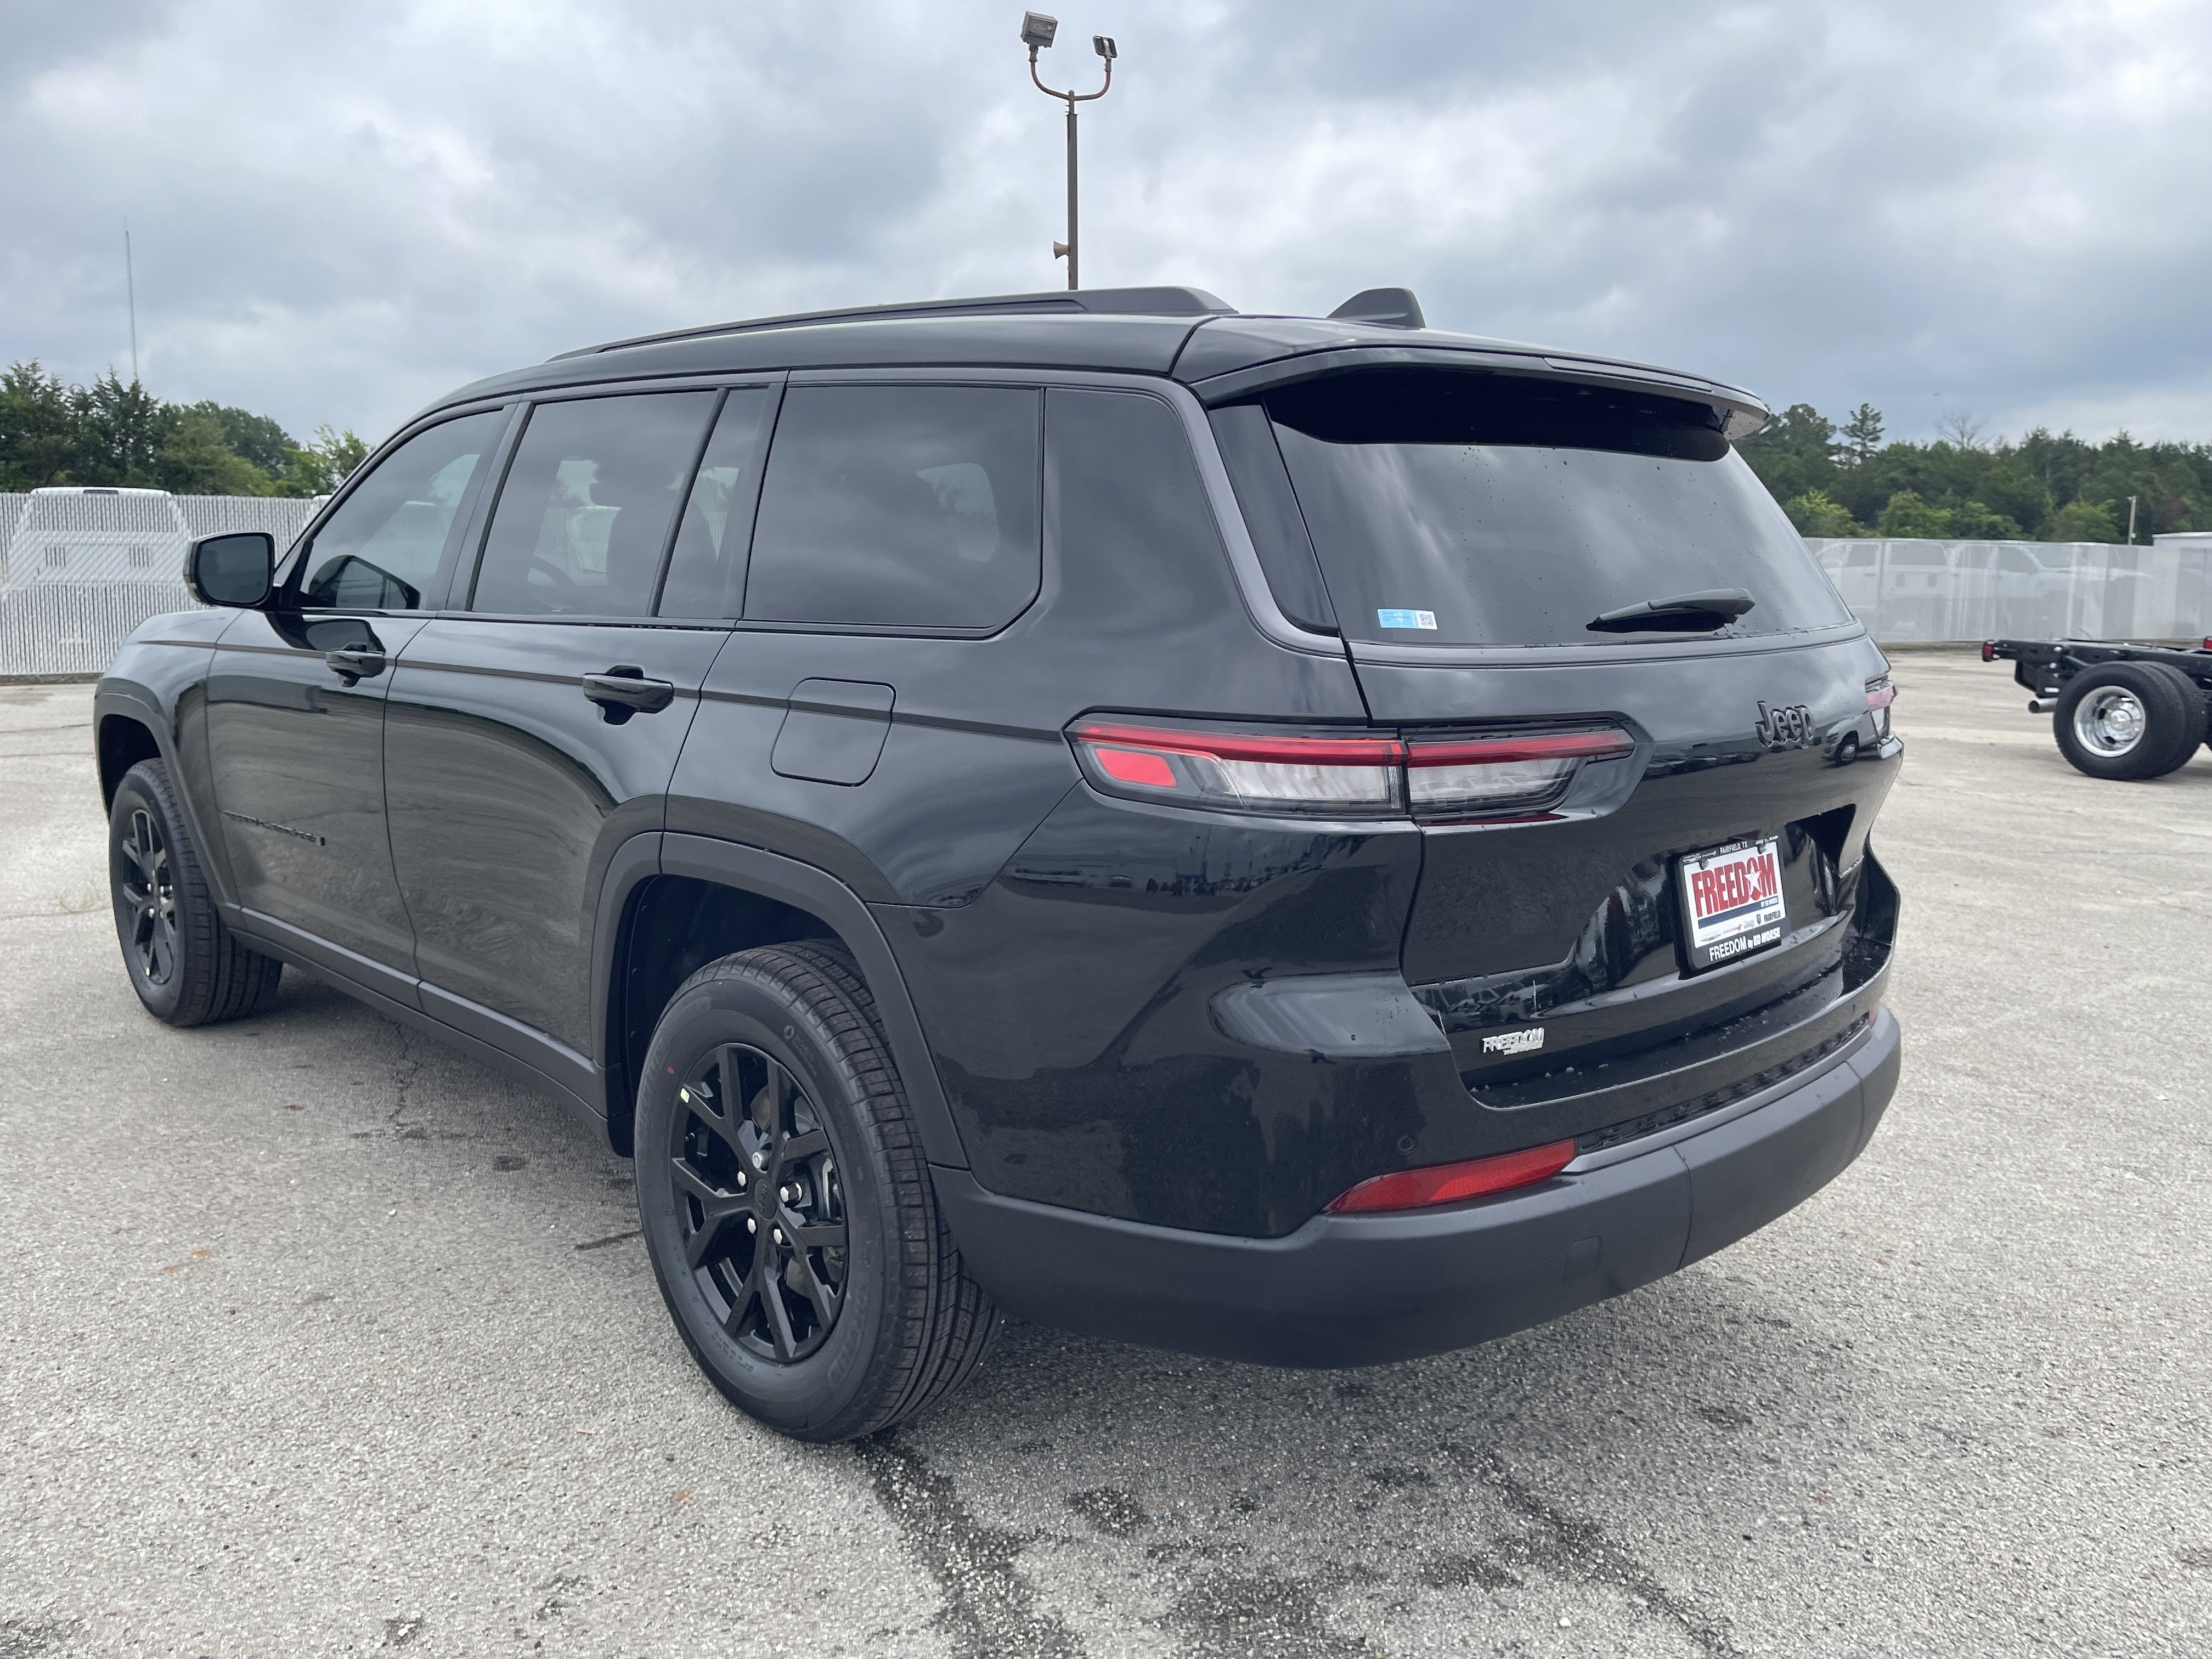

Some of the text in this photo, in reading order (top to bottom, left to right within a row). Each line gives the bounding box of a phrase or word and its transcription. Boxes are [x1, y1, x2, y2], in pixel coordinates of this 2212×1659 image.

[1756, 701, 1815, 749] Jeep
[1691, 853, 1778, 918] FREEDOM
[1709, 936, 1747, 962] FREEDOM
[1753, 934, 1761, 946] ED
[1761, 927, 1781, 943] MORSE
